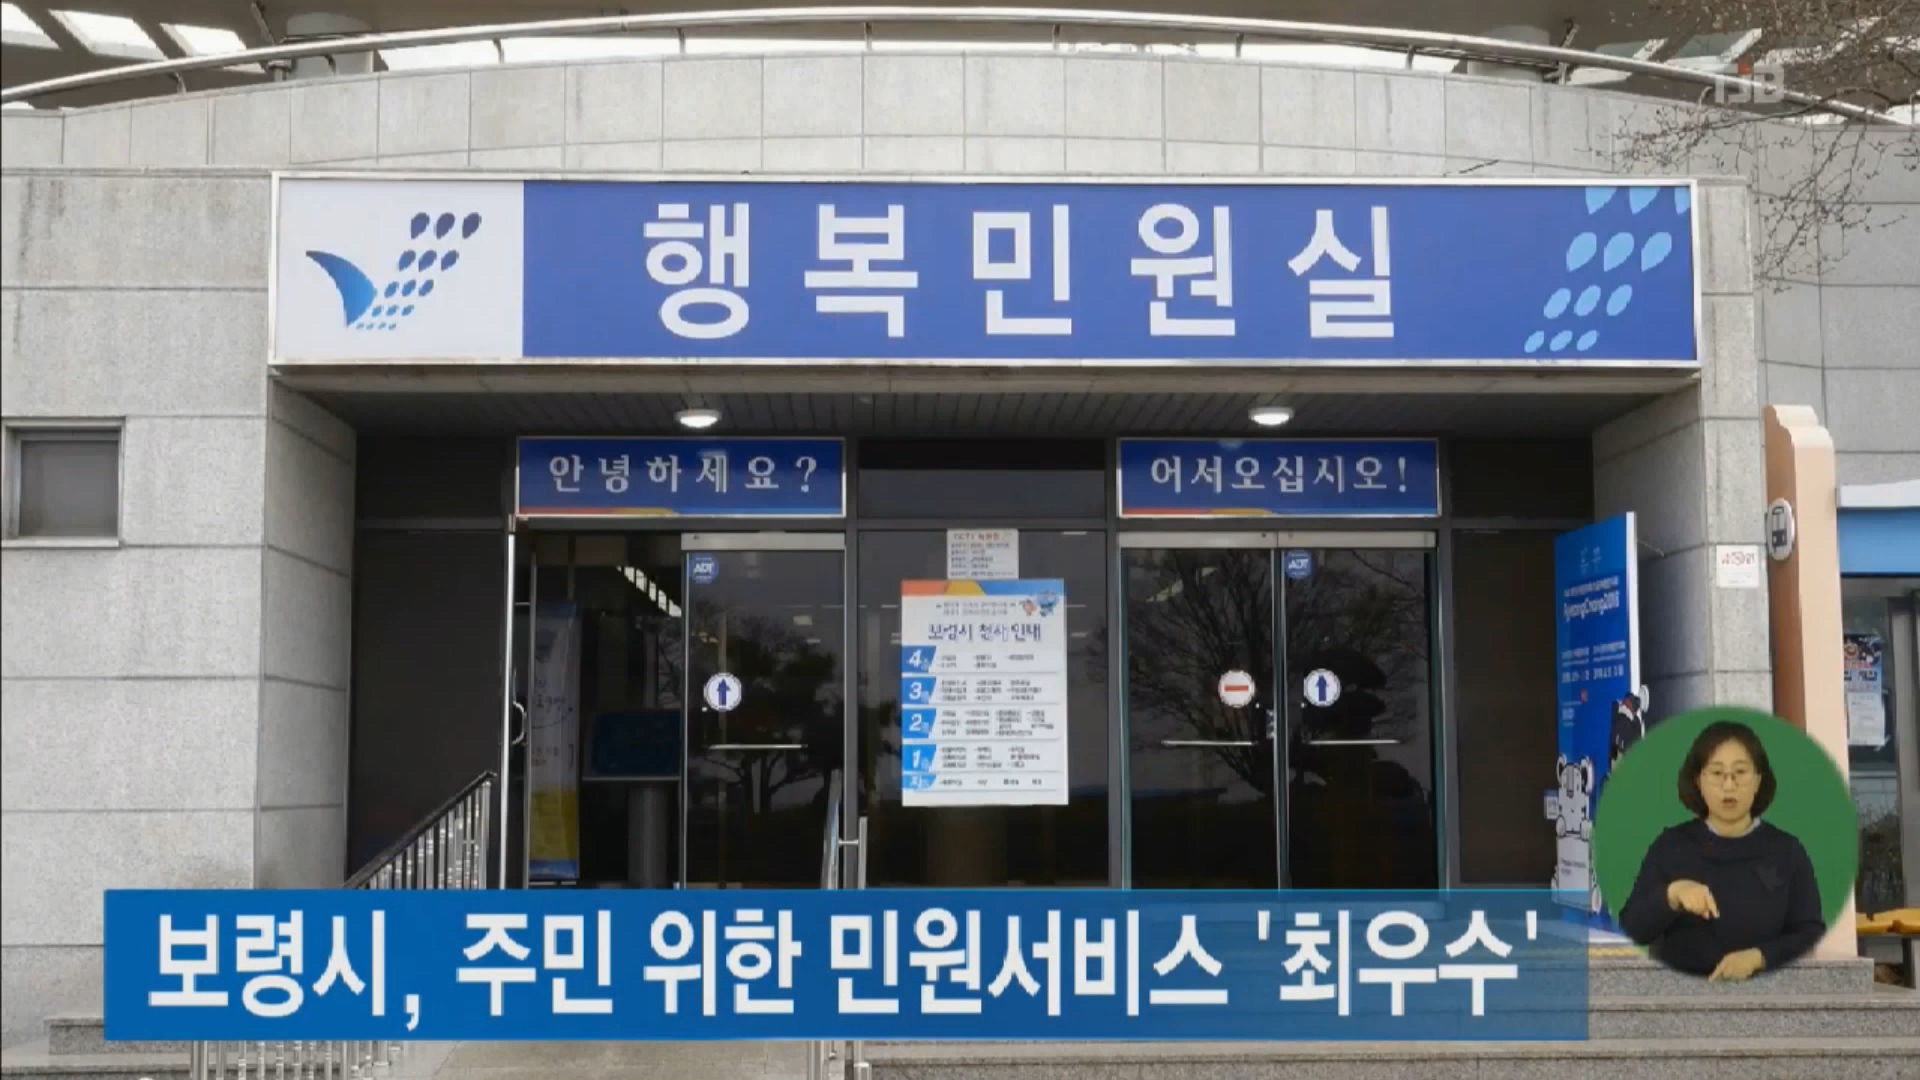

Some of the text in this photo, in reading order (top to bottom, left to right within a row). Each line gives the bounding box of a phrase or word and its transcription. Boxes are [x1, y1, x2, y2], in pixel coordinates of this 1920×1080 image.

[643, 203, 1394, 339] 행복민원실
[549, 453, 818, 494] 안녕하세요?
[1150, 455, 1408, 494] 어서오십시오!
